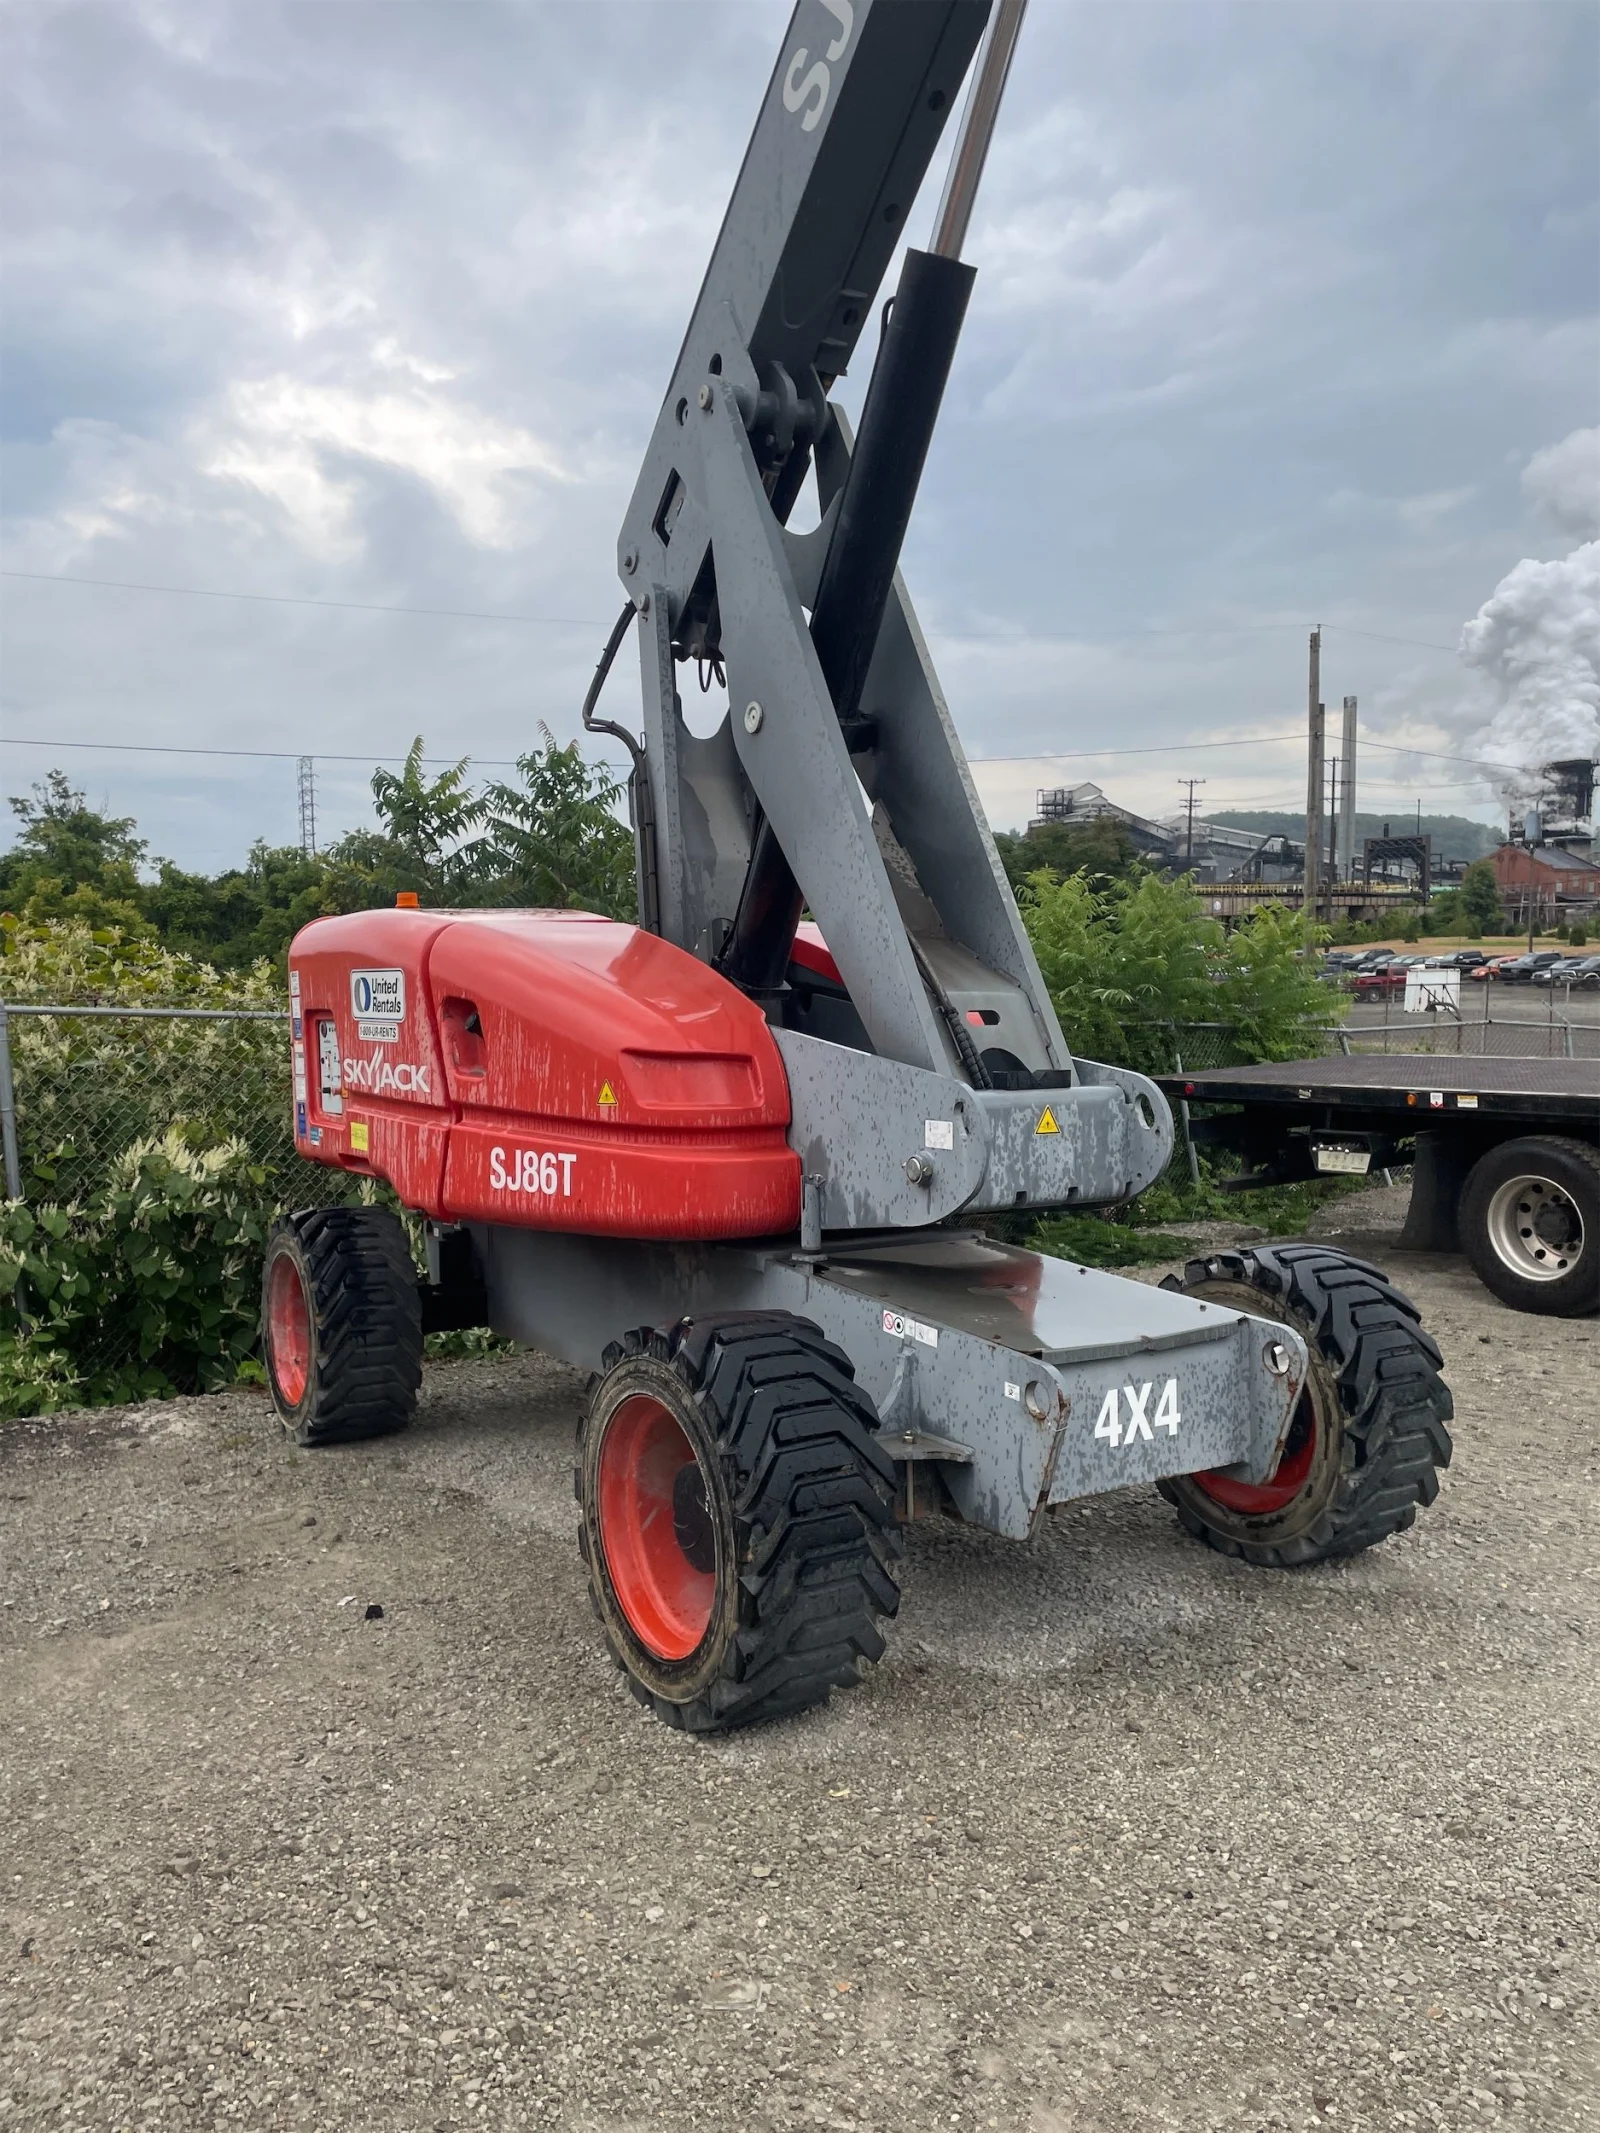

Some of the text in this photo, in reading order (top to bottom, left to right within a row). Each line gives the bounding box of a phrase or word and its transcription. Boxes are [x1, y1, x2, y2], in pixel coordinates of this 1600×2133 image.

[371, 977, 398, 994] United
[372, 996, 401, 1013] Rentals
[359, 1026, 397, 1038] 1-800-UR-RENTS
[343, 1045, 430, 1093] SKYJACK
[489, 1147, 577, 1196] SJ86T
[1094, 1377, 1181, 1447] 4X4
